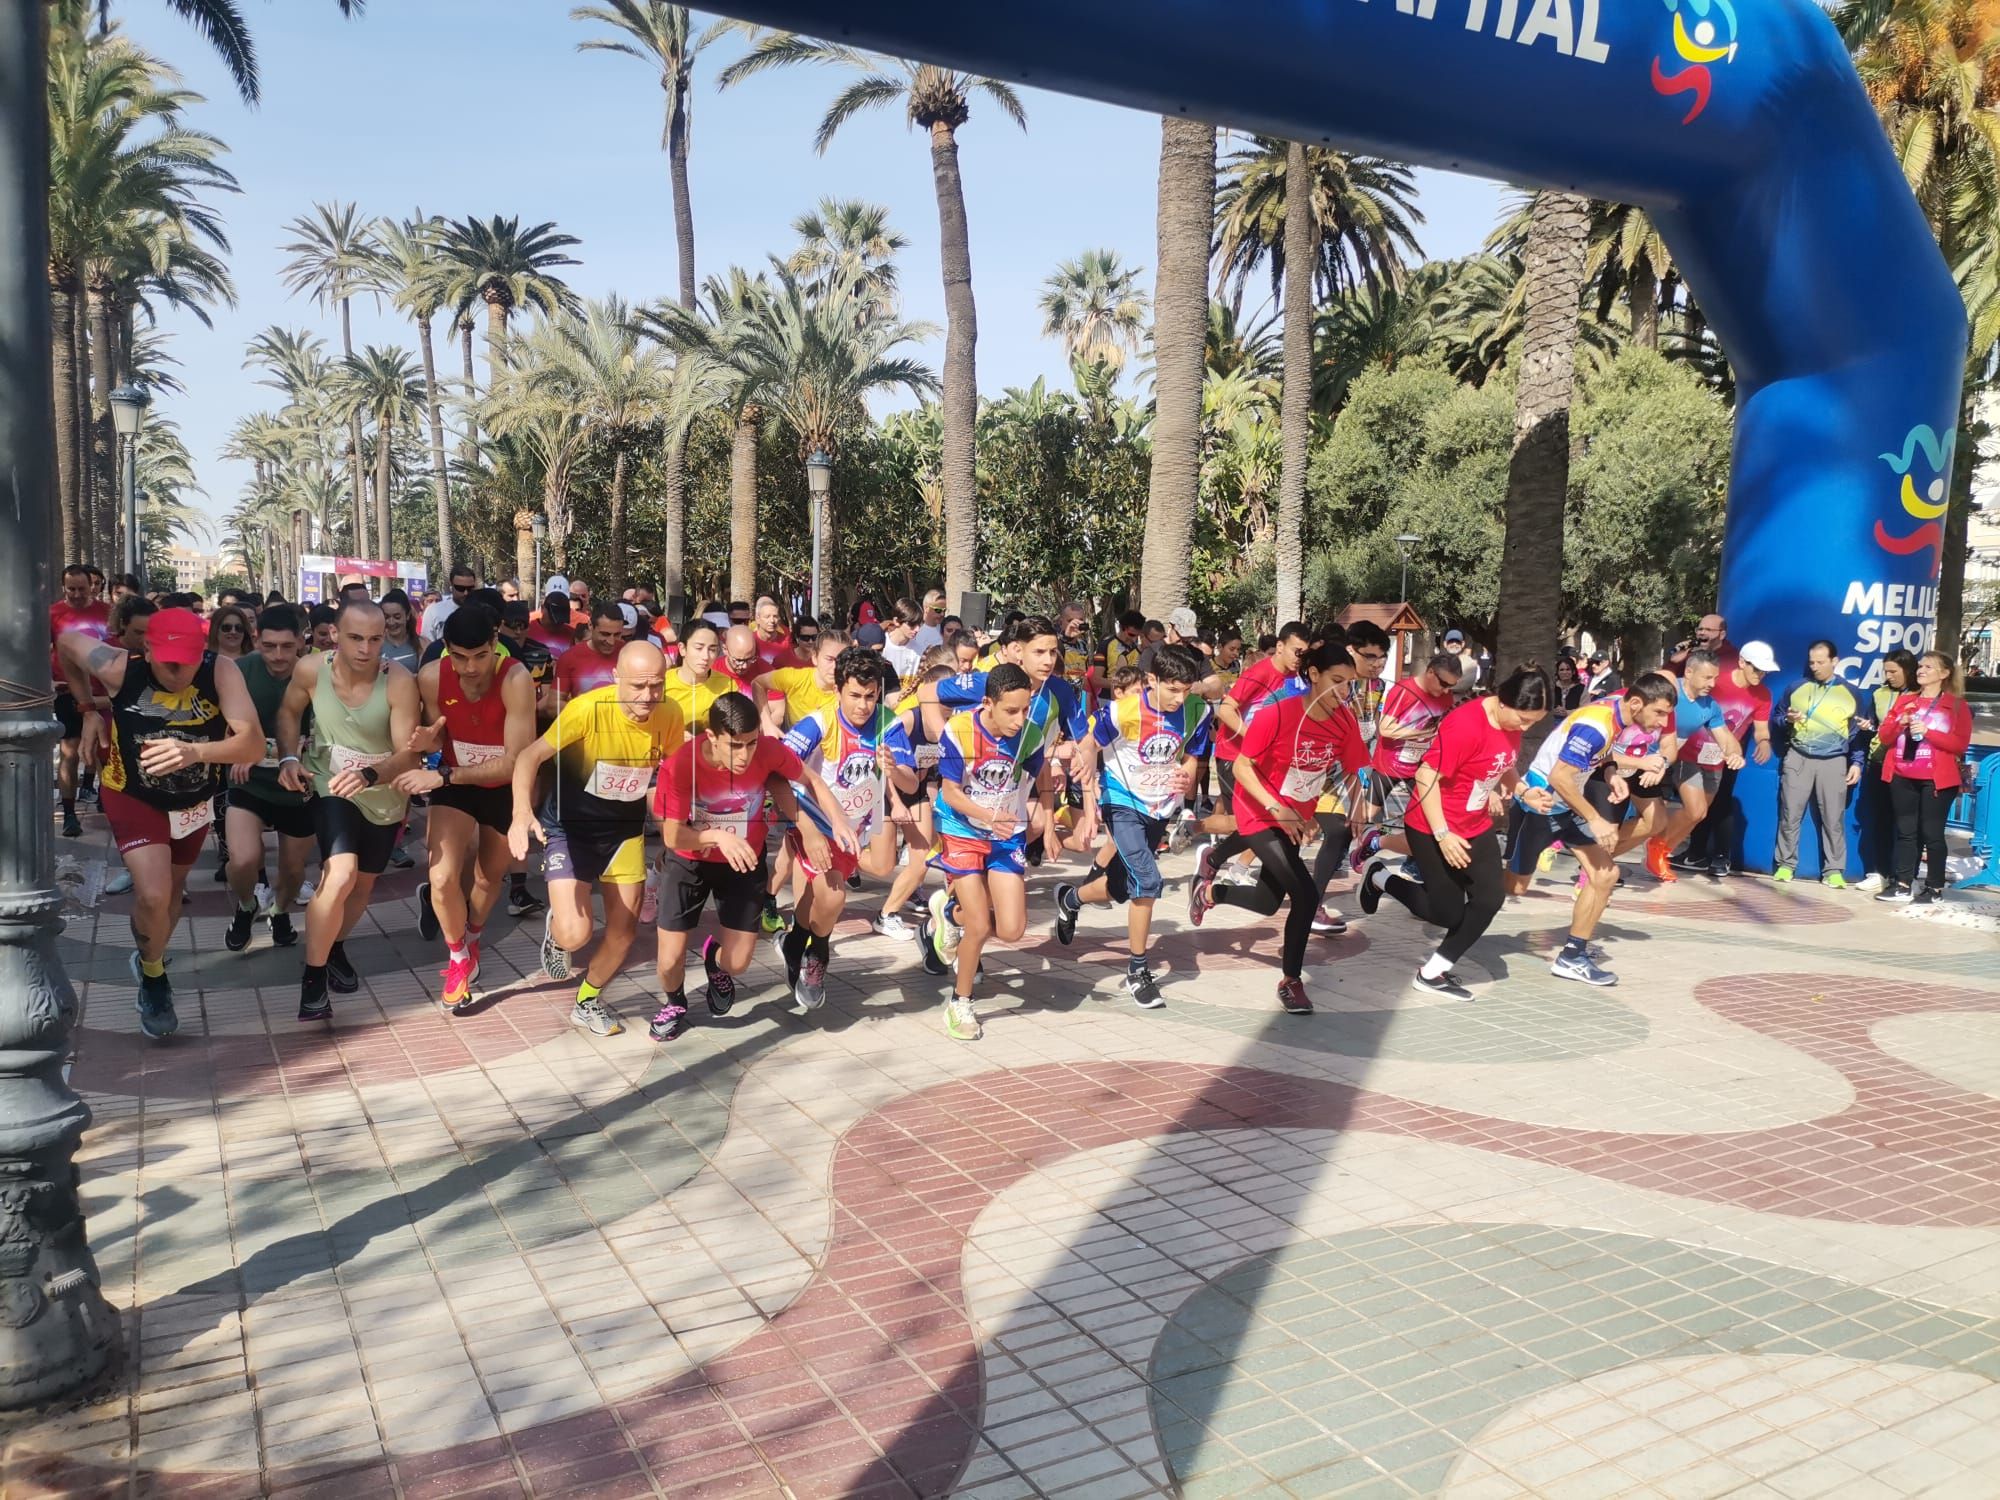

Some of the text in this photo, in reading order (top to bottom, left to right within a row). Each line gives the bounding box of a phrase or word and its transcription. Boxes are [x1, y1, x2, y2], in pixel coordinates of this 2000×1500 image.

[342, 759, 370, 770] 25
[466, 751, 498, 766] 27
[601, 776, 640, 793] 348
[1140, 773, 1170, 787] 222
[841, 788, 874, 812] 203
[179, 807, 208, 826] 353
